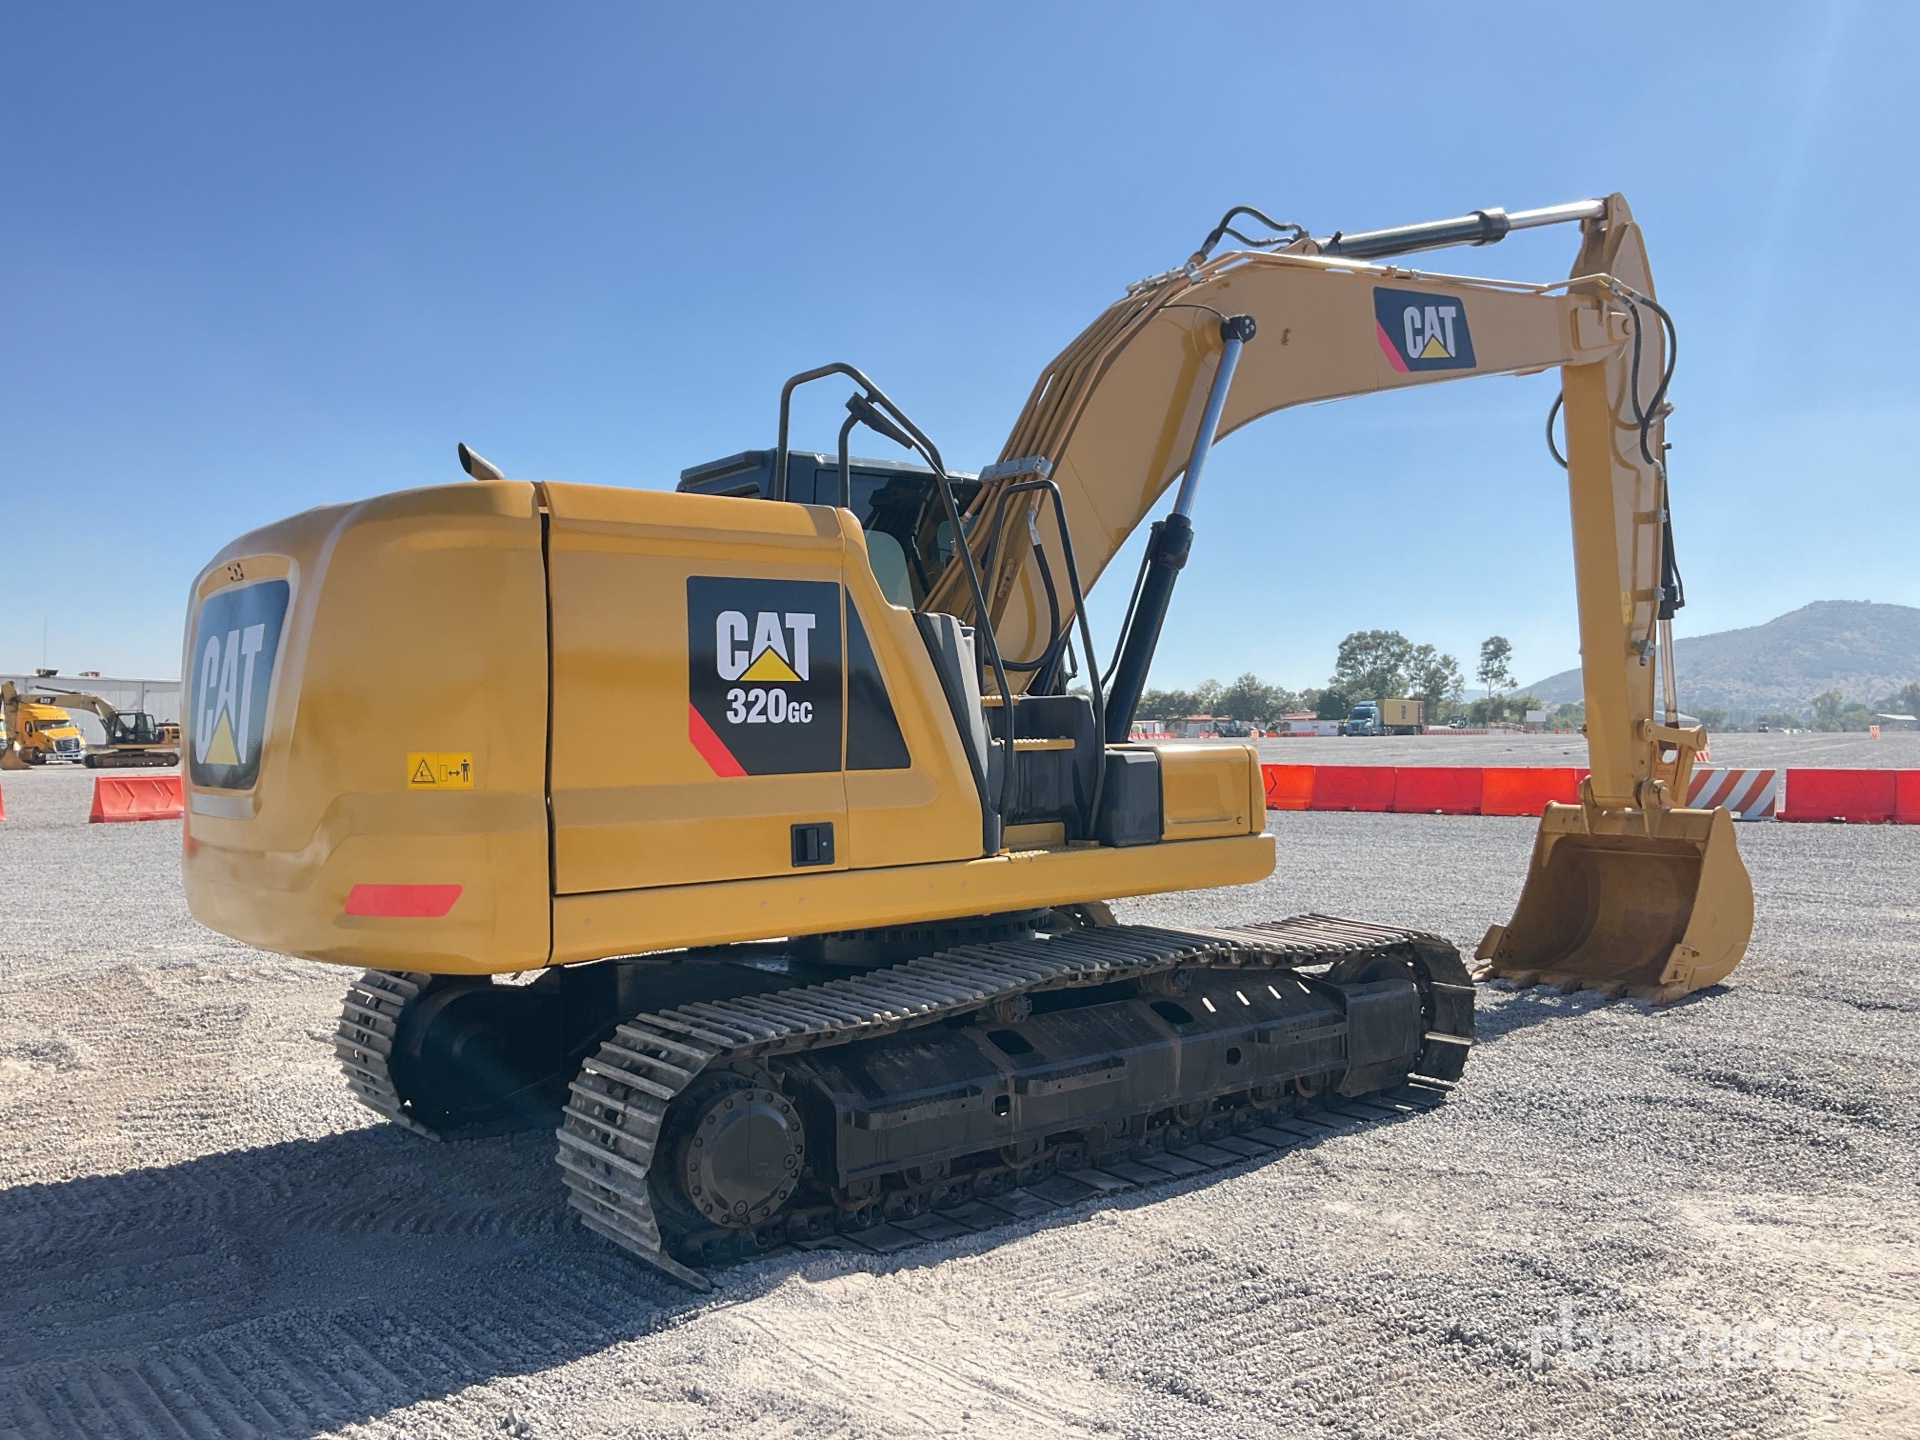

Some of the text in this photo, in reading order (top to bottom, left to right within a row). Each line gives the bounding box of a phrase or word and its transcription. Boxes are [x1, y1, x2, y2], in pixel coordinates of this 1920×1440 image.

[1403, 306, 1457, 359] CAT
[716, 610, 816, 681] CAT
[195, 623, 265, 766] CAT
